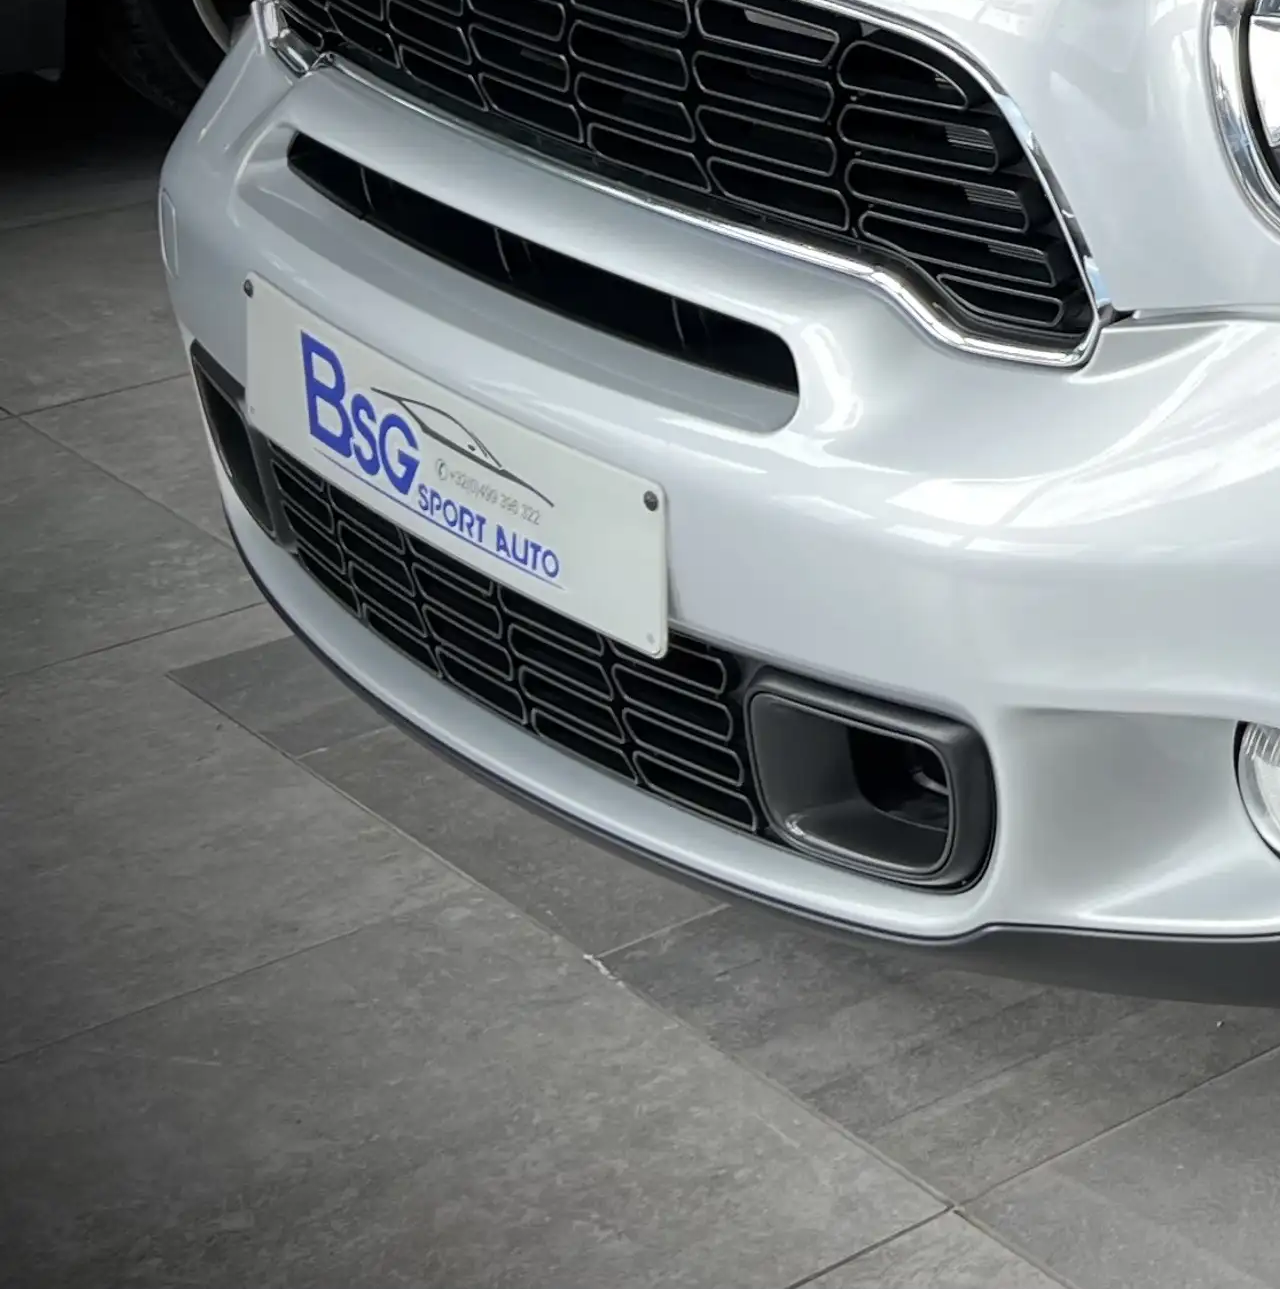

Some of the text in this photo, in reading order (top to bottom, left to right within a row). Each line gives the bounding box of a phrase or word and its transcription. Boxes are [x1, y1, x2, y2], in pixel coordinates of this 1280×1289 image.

[301, 330, 419, 495] BSG
[417, 483, 561, 579] SPORT AUTO
